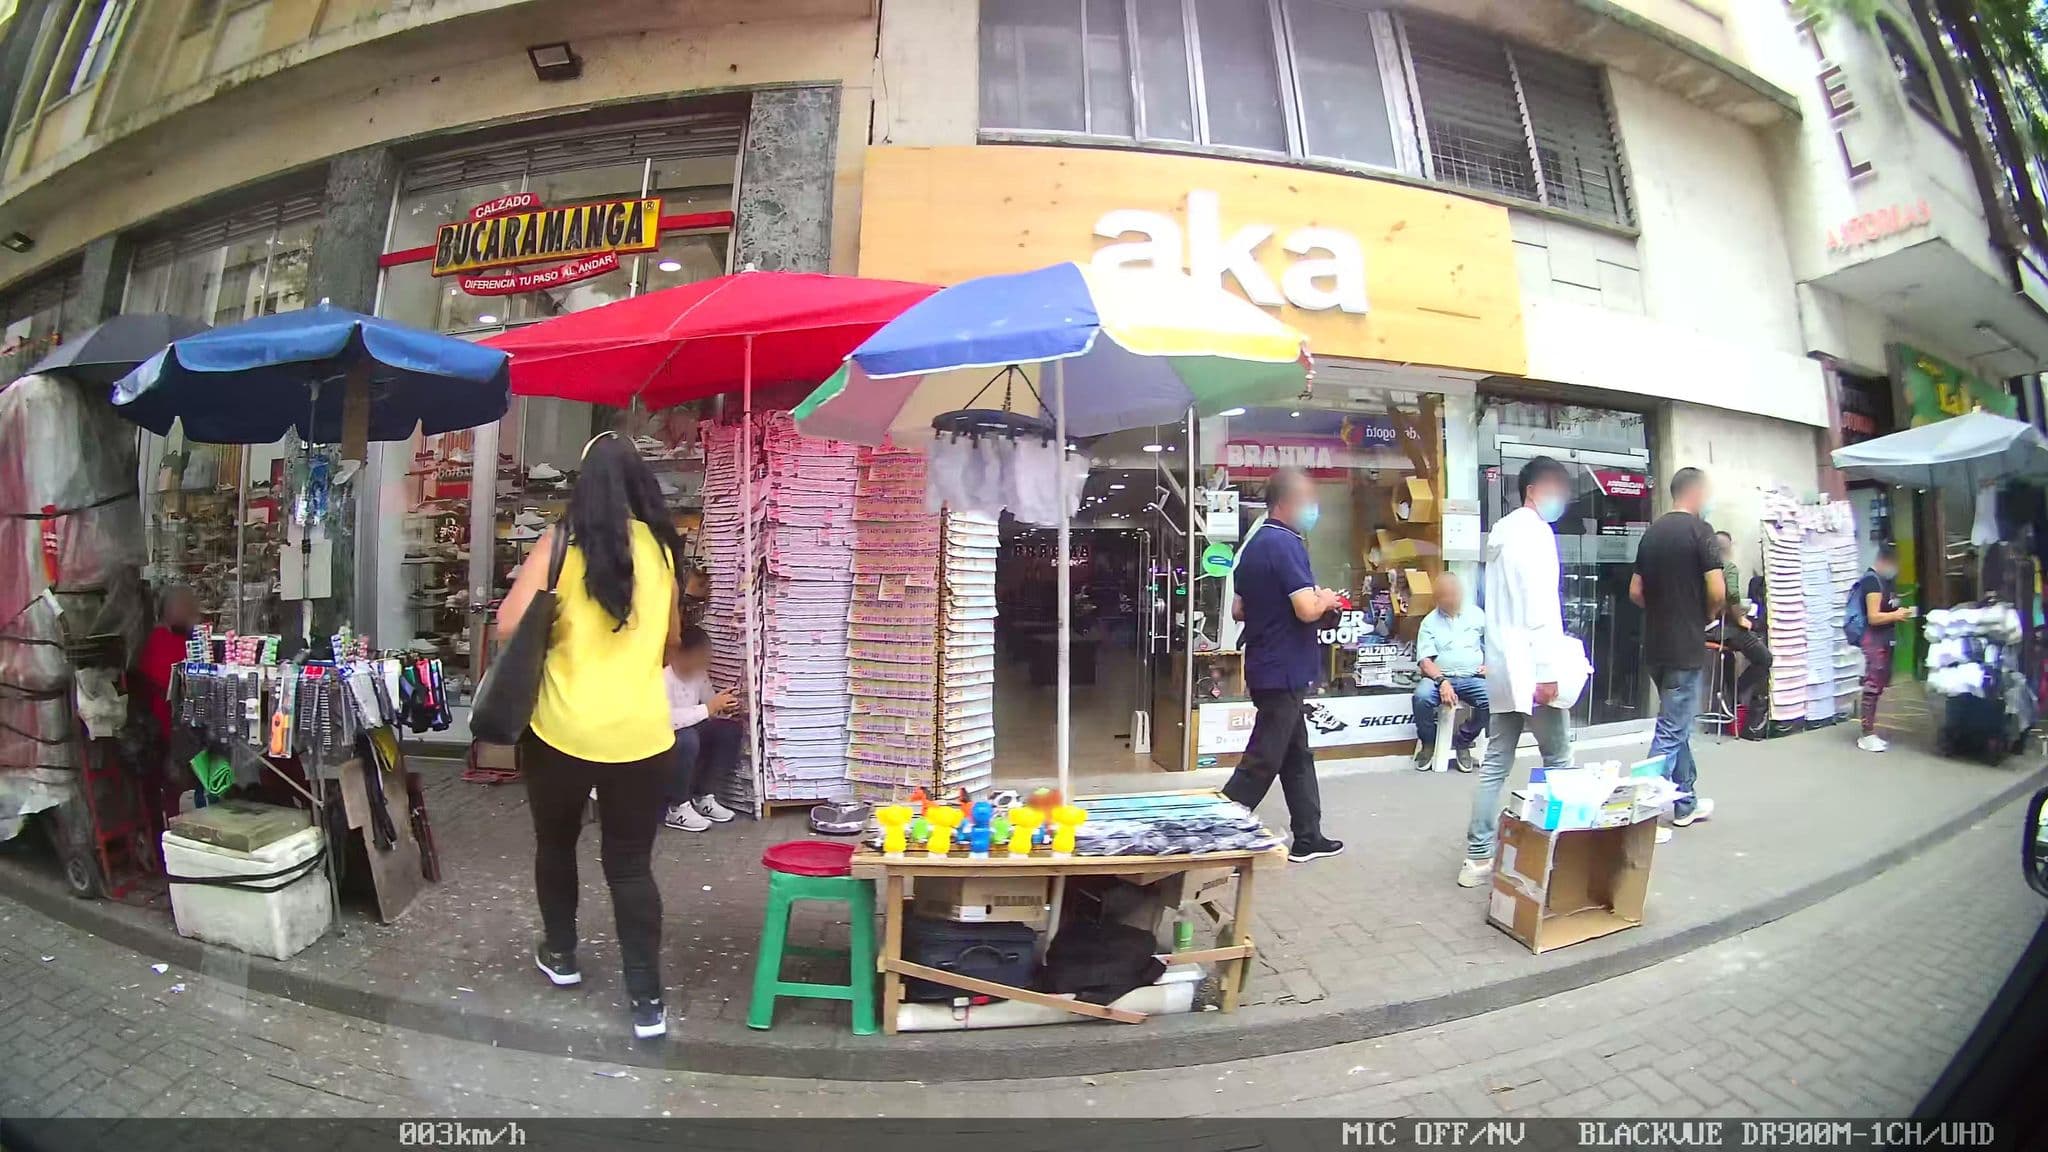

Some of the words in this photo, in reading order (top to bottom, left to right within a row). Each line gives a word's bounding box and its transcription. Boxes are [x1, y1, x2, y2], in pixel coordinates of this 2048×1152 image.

[1788, 0, 1873, 179] TEL
[475, 195, 531, 219] CALZADO
[435, 202, 644, 269] BUCARAMANGA
[1090, 188, 1368, 315] aka
[464, 275, 516, 290] DIFERENCIA
[519, 275, 532, 287] TU
[533, 270, 559, 285] PASO
[562, 265, 577, 277] AL
[577, 255, 613, 274] ANDAR
[1358, 646, 1397, 656] CALZADO
[1231, 711, 1254, 728] ak
[1358, 714, 1417, 728] SKECH
